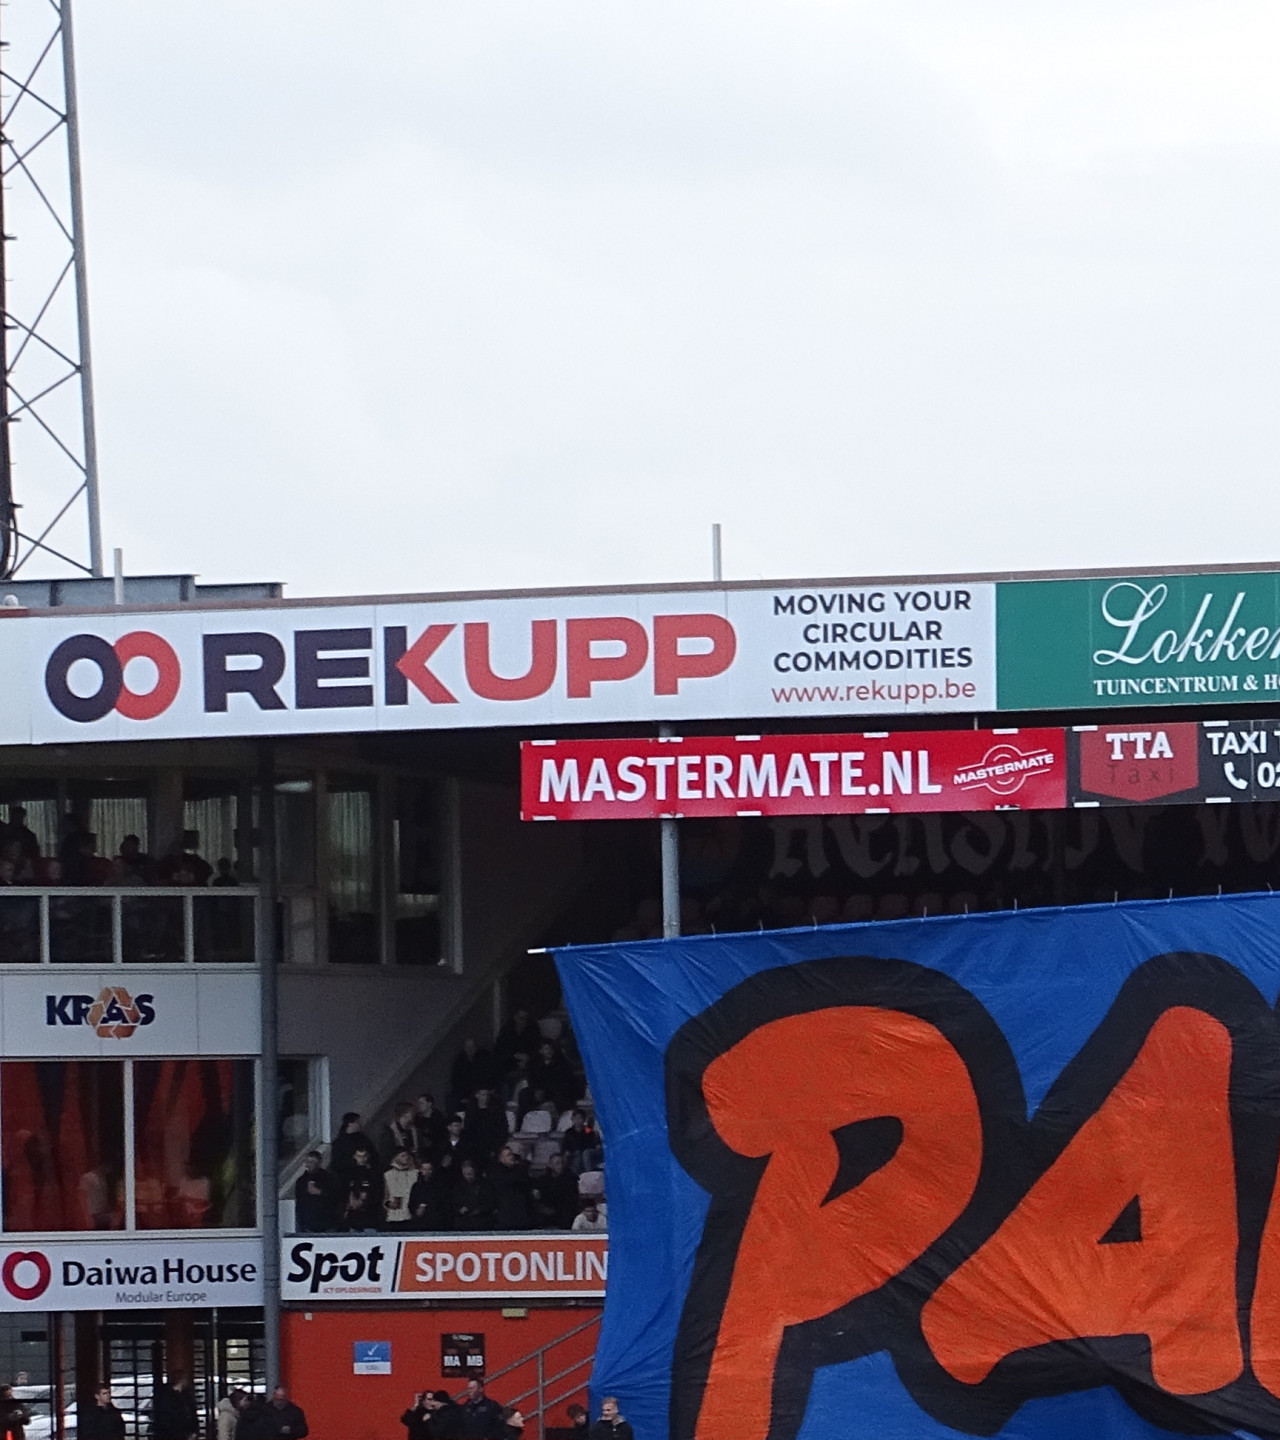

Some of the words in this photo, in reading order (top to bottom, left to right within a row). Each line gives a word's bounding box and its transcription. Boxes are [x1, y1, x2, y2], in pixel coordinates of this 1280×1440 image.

[772, 591, 886, 617] MOVING
[893, 589, 972, 613] YOUR
[802, 620, 943, 646] CIRCULAR
[203, 613, 737, 713] REKUPP
[773, 646, 973, 673] COMMODITIES
[771, 679, 977, 705] www.rekupp.be
[1093, 674, 1239, 696] TUINCENTRUM
[1243, 674, 1259, 692] &
[1105, 730, 1174, 761] TTA
[1205, 730, 1268, 755] TAXI
[538, 748, 943, 803] MASTERMATE.NL
[952, 752, 1055, 785] MASTERMATE
[1106, 761, 1175, 786] Taxi
[61, 1259, 158, 1287] Daiwa
[162, 1257, 258, 1285] House
[286, 1241, 385, 1294] Spot
[414, 1251, 610, 1283] SPOTONLIN
[115, 1290, 163, 1304] Modular
[165, 1289, 208, 1305] Europe
[442, 1354, 462, 1367] MA
[466, 1354, 484, 1367] MB
